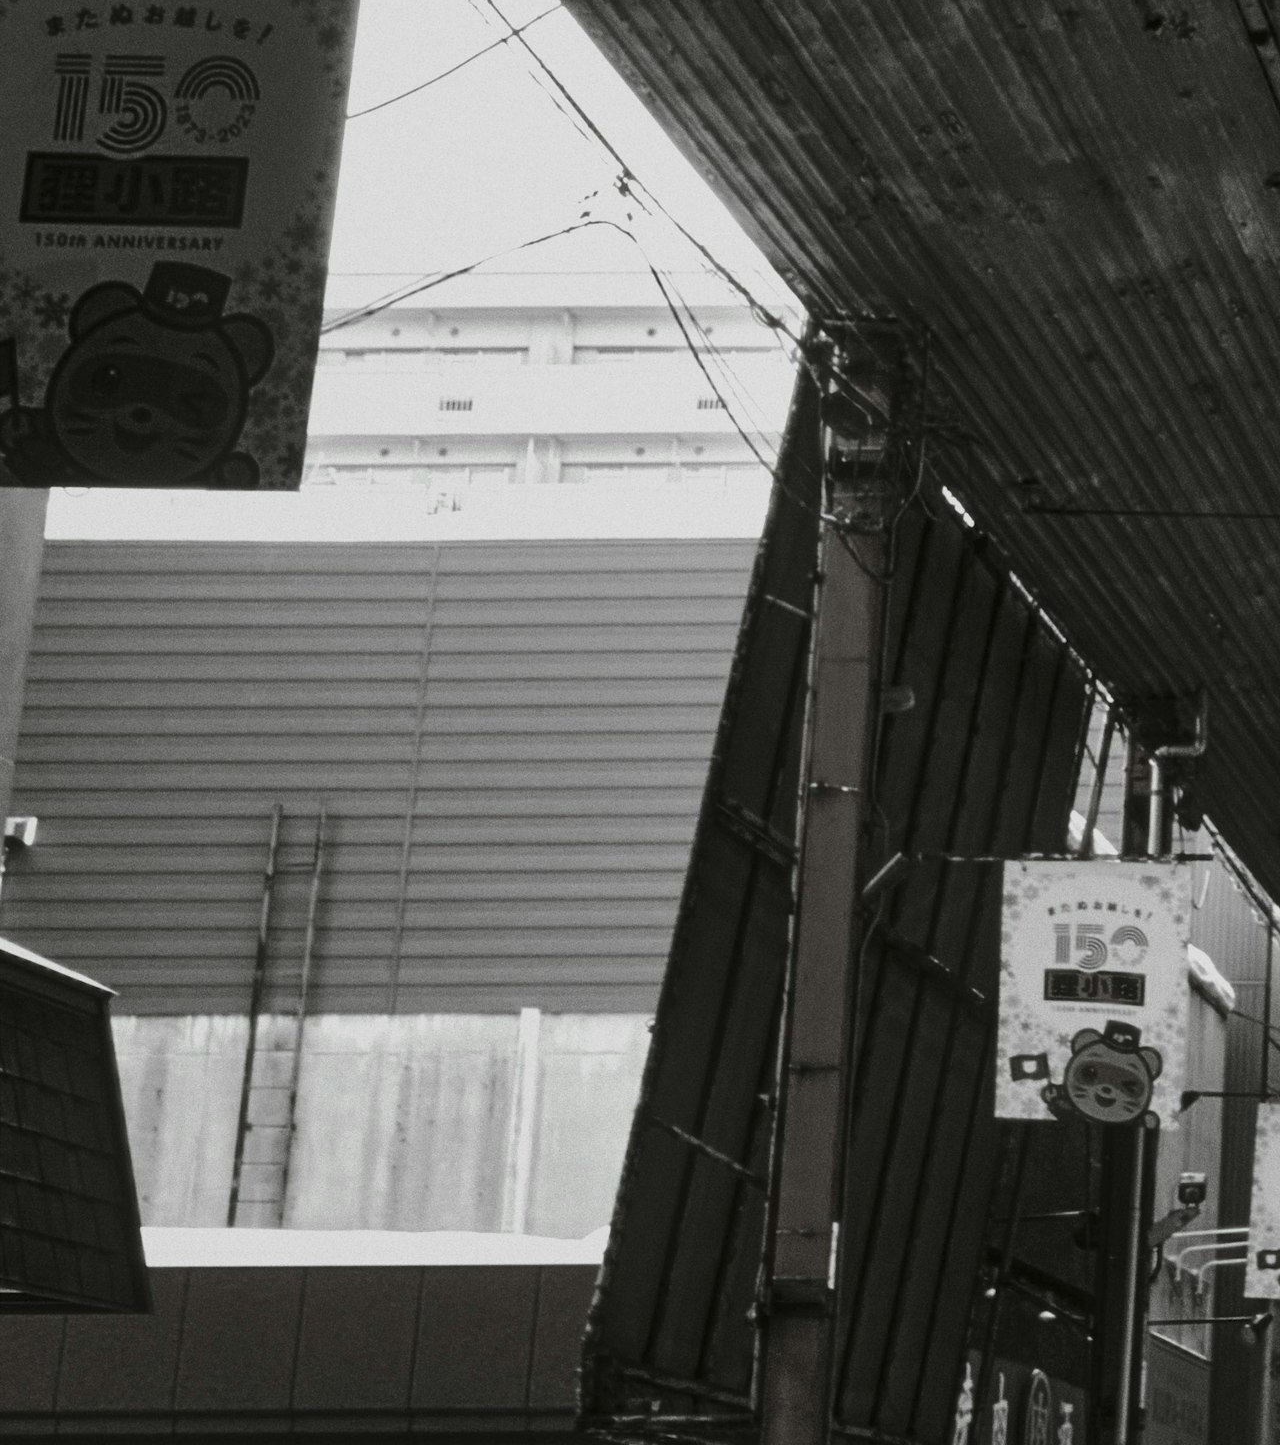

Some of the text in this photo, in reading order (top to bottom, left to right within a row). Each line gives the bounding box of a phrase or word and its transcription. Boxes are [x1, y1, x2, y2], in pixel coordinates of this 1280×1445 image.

[54, 53, 260, 155] 150
[34, 232, 224, 252] 150th ANNIVERSARY
[1053, 923, 1149, 971] 150
